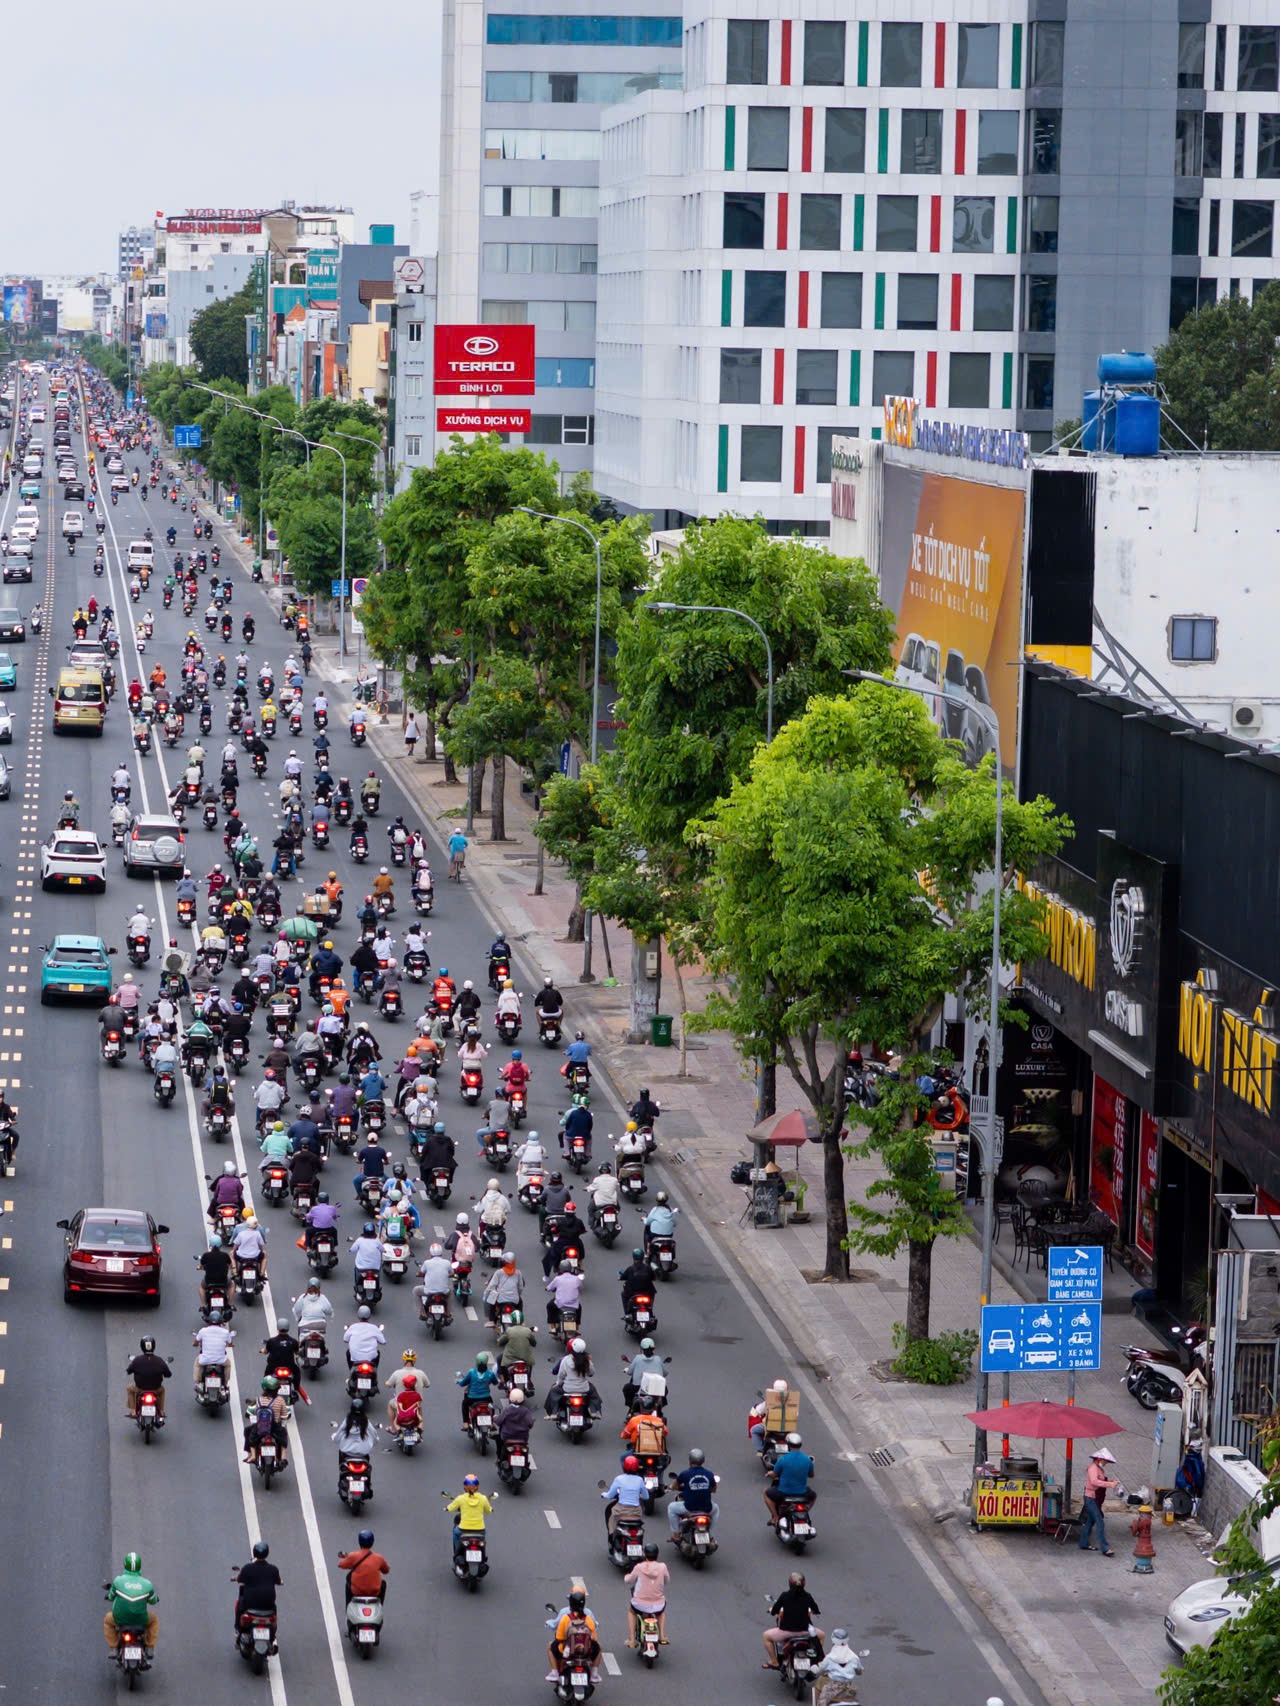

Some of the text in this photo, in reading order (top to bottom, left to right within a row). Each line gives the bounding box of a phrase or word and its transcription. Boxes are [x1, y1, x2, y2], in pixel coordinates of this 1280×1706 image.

[448, 361, 515, 372] TERACO
[460, 383, 503, 394] BÌNH LỢI
[445, 414, 524, 427] XƯỞNG DỊCH VỤ
[911, 521, 990, 599] XE TỐT DỊCH VỤ TỐT
[910, 580, 927, 600] WELL
[1178, 967, 1213, 1090] NỘI
[1031, 1042, 1054, 1050] CASA
[1071, 1290, 1094, 1298] CAMERA
[1075, 1359, 1094, 1367] BÁNH
[978, 1491, 1039, 1518] XÔI CHIÊN
